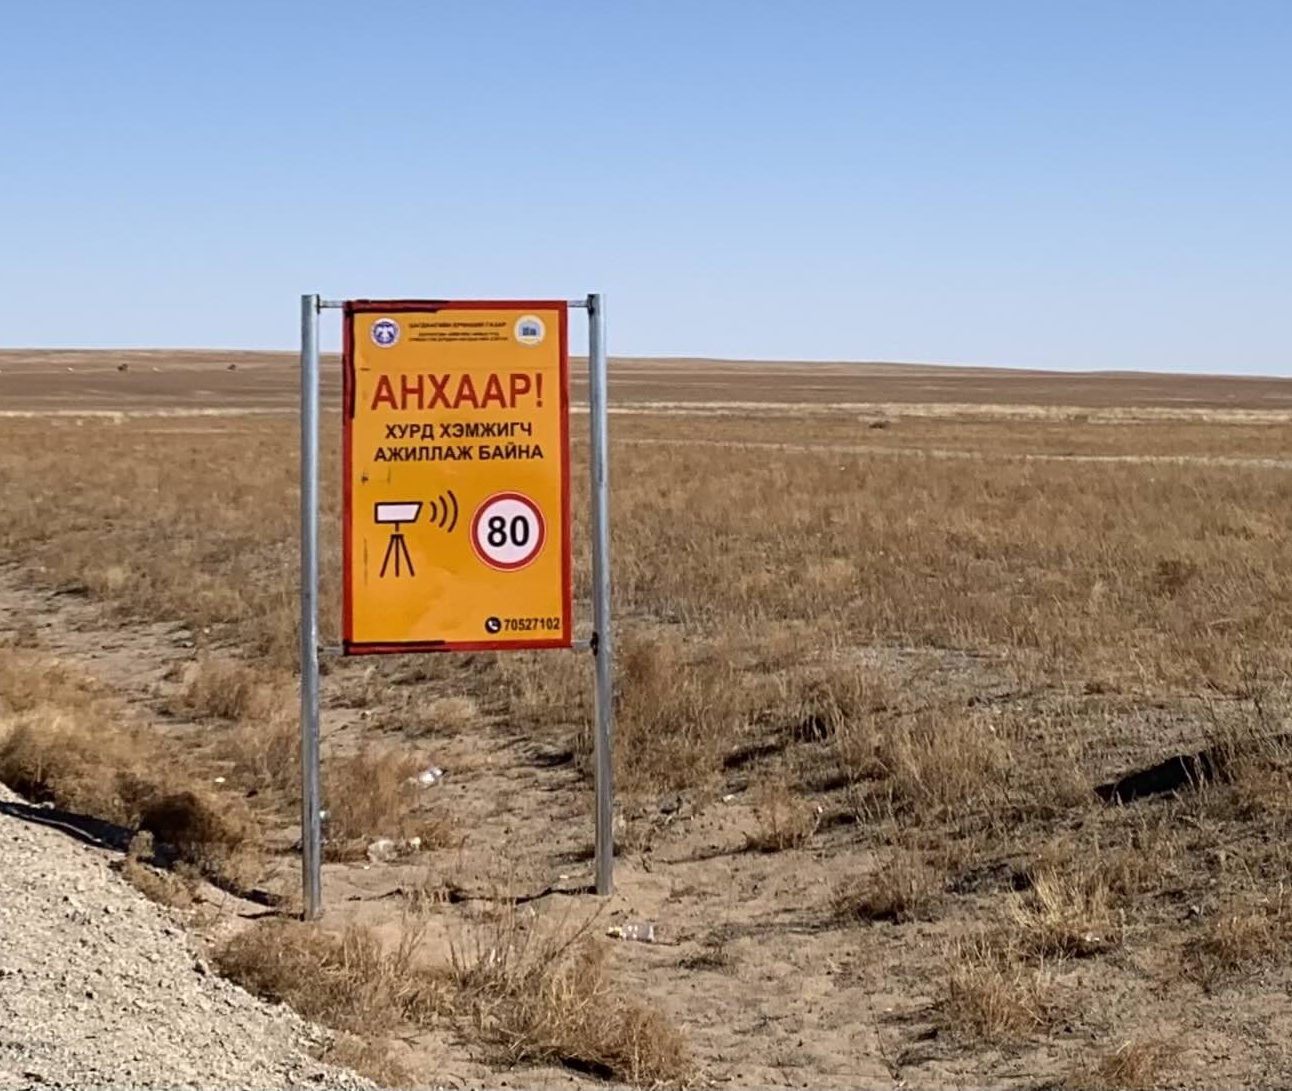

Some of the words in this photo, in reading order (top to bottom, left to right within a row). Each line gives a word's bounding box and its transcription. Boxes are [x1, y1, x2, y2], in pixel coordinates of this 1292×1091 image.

[371, 373, 543, 410] АНХААР!
[385, 423, 435, 441] ХУРД
[440, 422, 532, 439] ХЭМЖИГЧ
[374, 445, 473, 462] АЖИЛЛАЖ
[478, 442, 544, 460] БАЙНА
[487, 515, 530, 547] 80
[504, 617, 561, 631] 70527102
